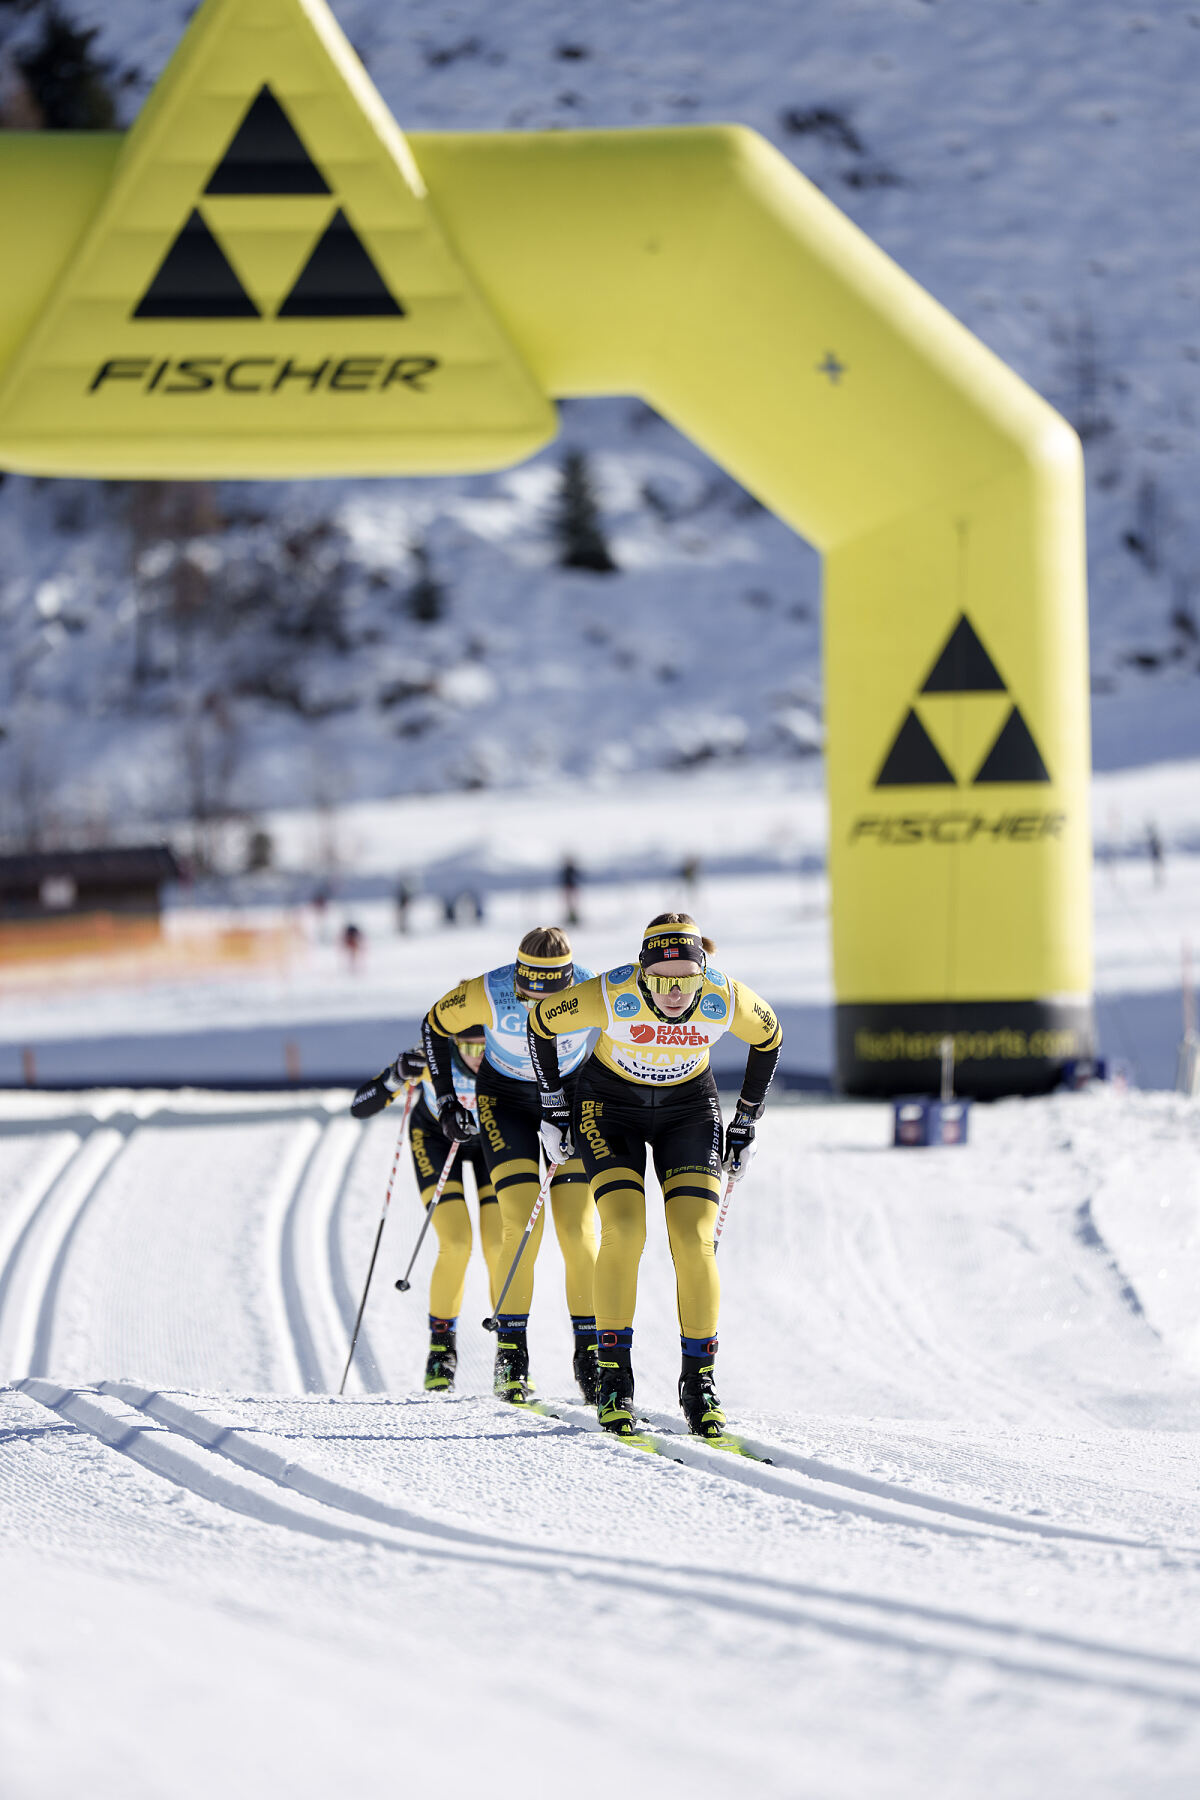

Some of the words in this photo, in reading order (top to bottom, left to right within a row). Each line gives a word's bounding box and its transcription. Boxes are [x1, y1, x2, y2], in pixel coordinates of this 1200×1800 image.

[88, 355, 440, 395] FISCHER
[849, 809, 1066, 845] FISCHER
[648, 937, 695, 950] engcon
[517, 967, 563, 981] engcon
[545, 997, 579, 1020] engcon
[753, 1002, 776, 1030] engcon
[529, 1031, 551, 1091] SWEDEMOUN
[478, 1094, 506, 1153] engcon
[579, 1100, 611, 1161] engcon
[708, 1097, 721, 1167] SWEDEMOUNT
